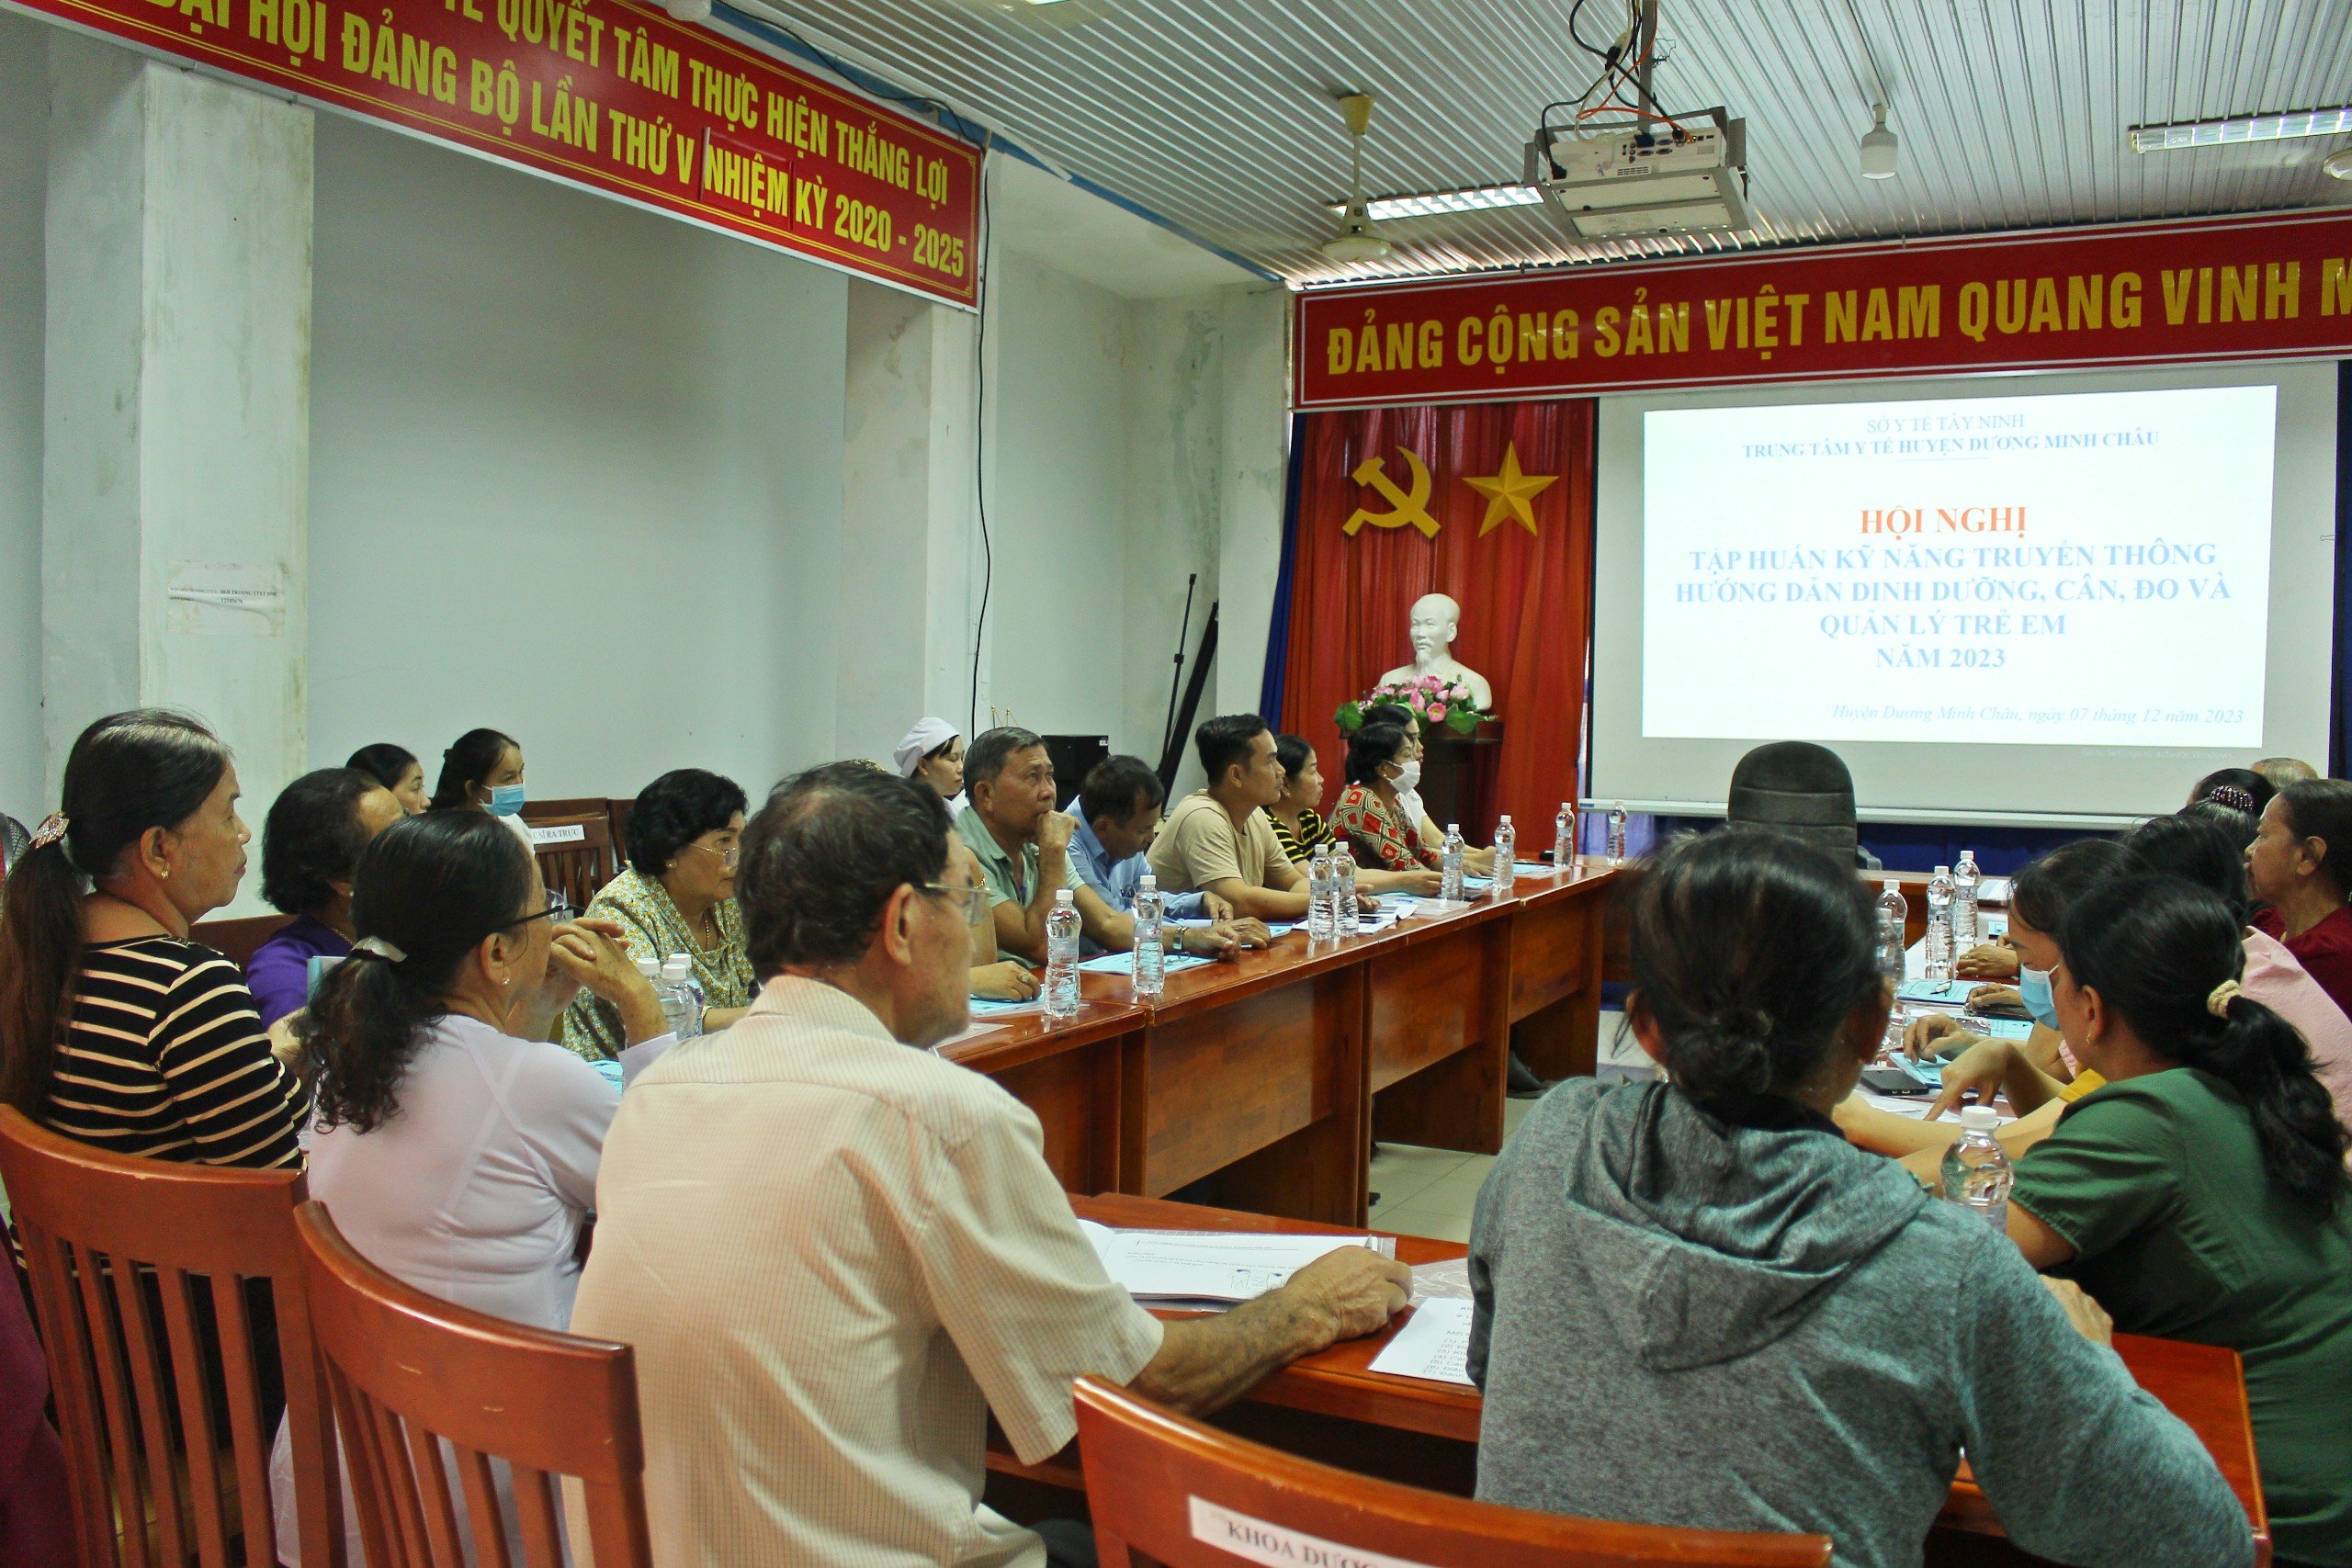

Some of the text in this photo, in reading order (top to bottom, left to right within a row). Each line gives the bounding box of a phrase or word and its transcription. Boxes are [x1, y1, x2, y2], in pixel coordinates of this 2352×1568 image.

[497, 0, 948, 209] QUYẾT TÂM THỰC HIỆN THẮNG LỢI
[341, 8, 457, 106] ĐẢNG
[469, 58, 521, 136] BỘ
[531, 73, 598, 152] LẦN
[608, 109, 673, 175] THỨ
[676, 134, 695, 185] V
[703, 144, 789, 219] NHIỆM
[795, 175, 829, 231] KỲ
[834, 195, 892, 253] 2020
[913, 228, 965, 277] 2025
[1328, 309, 1443, 376] ĐẢNG
[1457, 305, 1578, 374] CỘNG
[1594, 287, 1690, 357] SẢN
[1704, 284, 1810, 360] VIỆT
[1825, 285, 1940, 344] NAM
[1959, 272, 2142, 343] QUANG
[2162, 261, 2301, 325] VINH
[1894, 418, 1907, 433] Y
[1978, 412, 2025, 429] NINH
[1743, 442, 1806, 458] TRUNG
[1808, 437, 1850, 456] TÂM
[1854, 441, 1866, 455] Y
[1899, 437, 1964, 456] HUYỆN
[1969, 434, 2040, 451] DƯƠNG
[2044, 433, 2098, 448] MINH
[2102, 427, 2159, 446] CHÂU
[1860, 505, 2029, 542] HỘI NGHỊ
[1835, 541, 1876, 570] KỸ
[1883, 542, 1966, 570] NĂNG
[2107, 536, 2217, 566] THÔNG
[1677, 577, 1778, 603] HƯỚNG
[1851, 581, 1923, 603] DINH
[1930, 574, 2049, 604] DƯỠNG,
[2055, 573, 2127, 604] CÂN,
[2134, 578, 2180, 601] ĐO
[2188, 570, 2231, 599] VÀ
[1820, 608, 2067, 639] QUẢN LÝ TRẺ EM
[1875, 642, 2007, 669] NĂM 2023
[1937, 703, 1976, 720] Minh
[2068, 706, 2091, 723] 07
[2142, 707, 2164, 723] 12
[2204, 707, 2246, 725] 2023
[1227, 1520, 1296, 1560] KHOA
